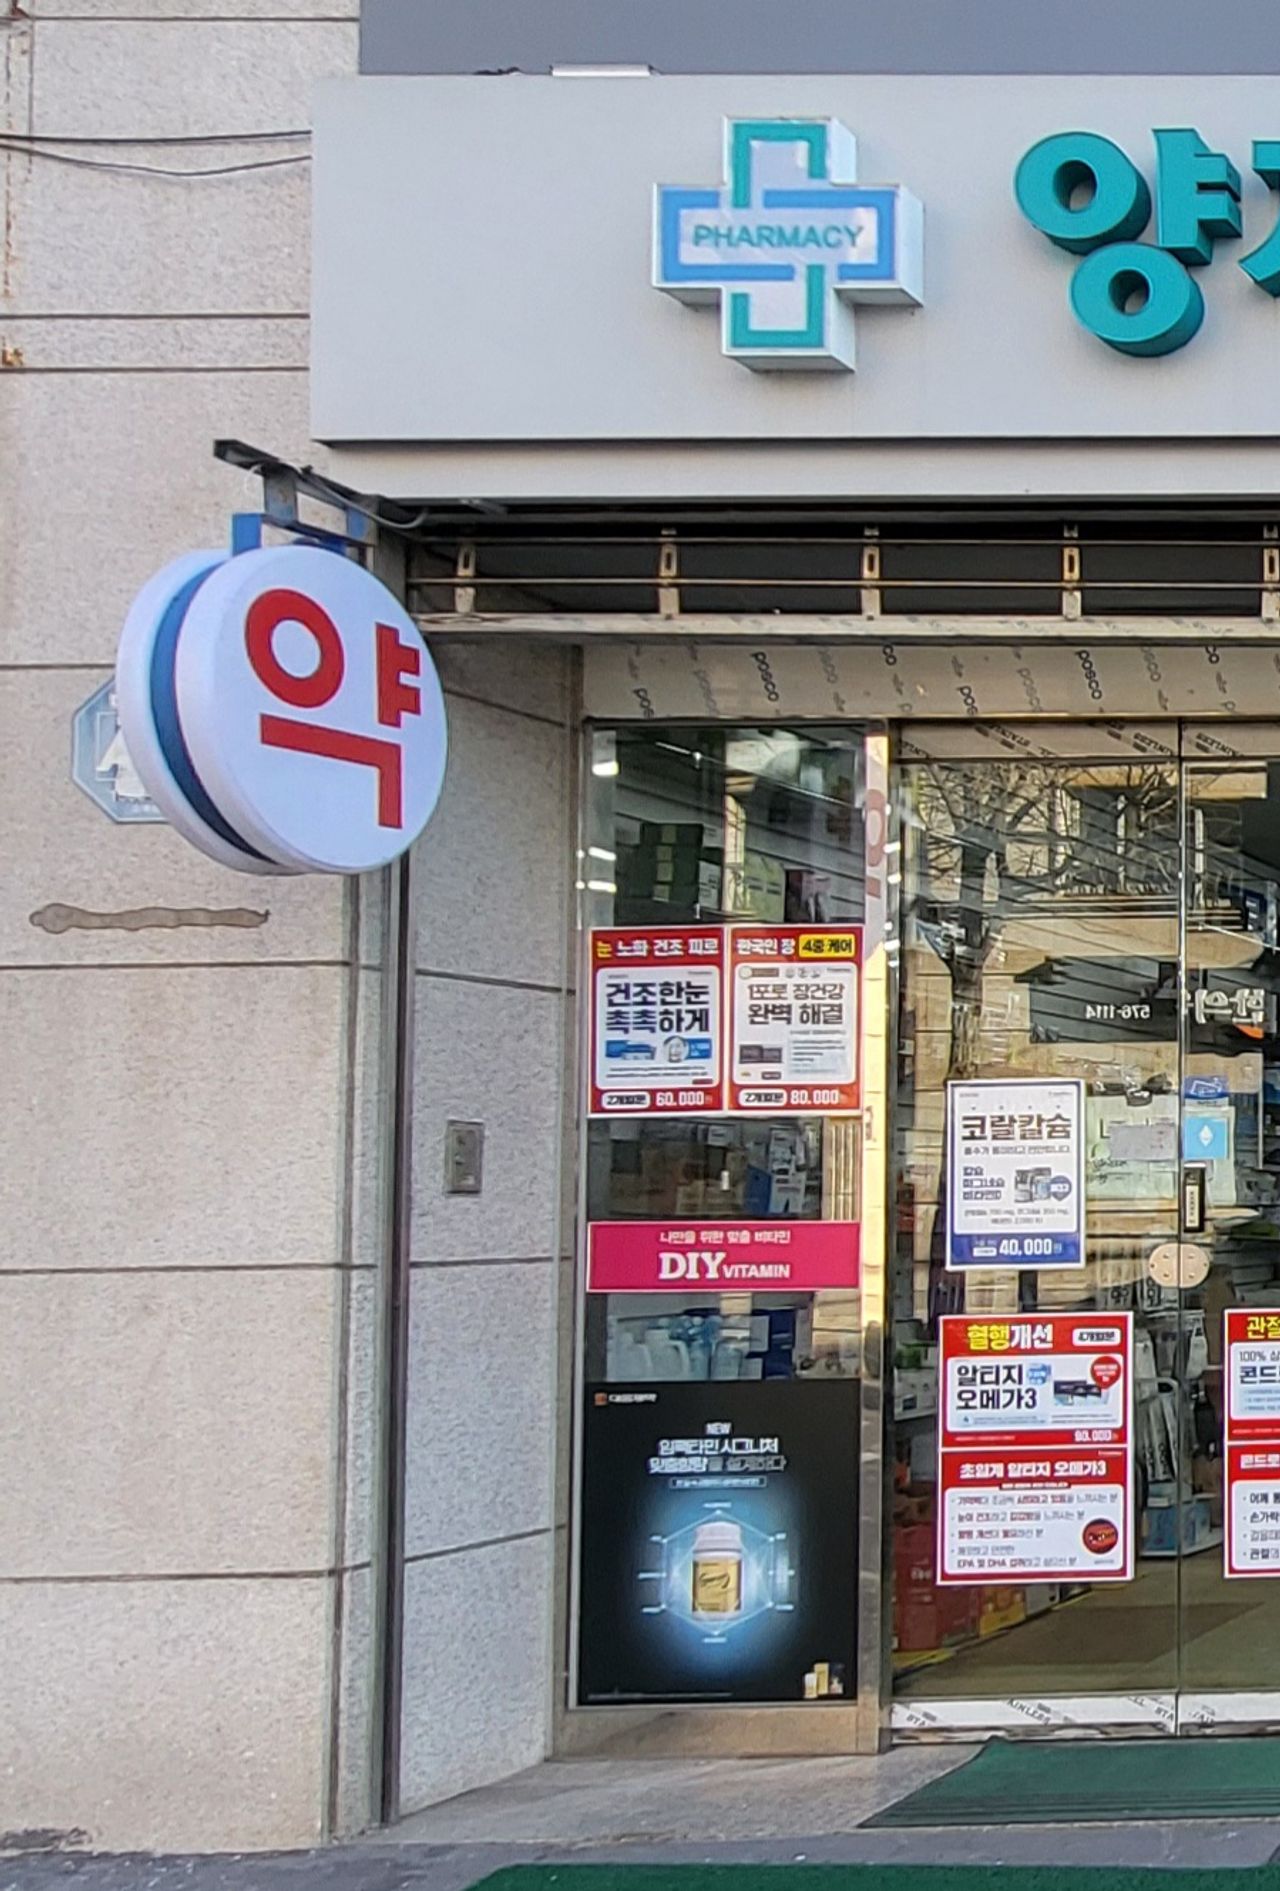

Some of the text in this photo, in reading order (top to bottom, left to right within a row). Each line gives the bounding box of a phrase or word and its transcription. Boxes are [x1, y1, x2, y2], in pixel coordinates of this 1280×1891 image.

[693, 224, 864, 249] PHARMACY
[245, 588, 421, 829] 약
[606, 981, 709, 1007] 건조한눈
[793, 983, 845, 1000] 장건강
[606, 1008, 709, 1034] 촉촉하게
[749, 1003, 843, 1025] 완벽 해결
[962, 1113, 1072, 1141] 코랄칼슘
[659, 1251, 791, 1280] DIY VITAMIN
[967, 1324, 1053, 1350] 혈행개선
[957, 1364, 1023, 1386] 알티지
[956, 1388, 1038, 1410] 오메가3
